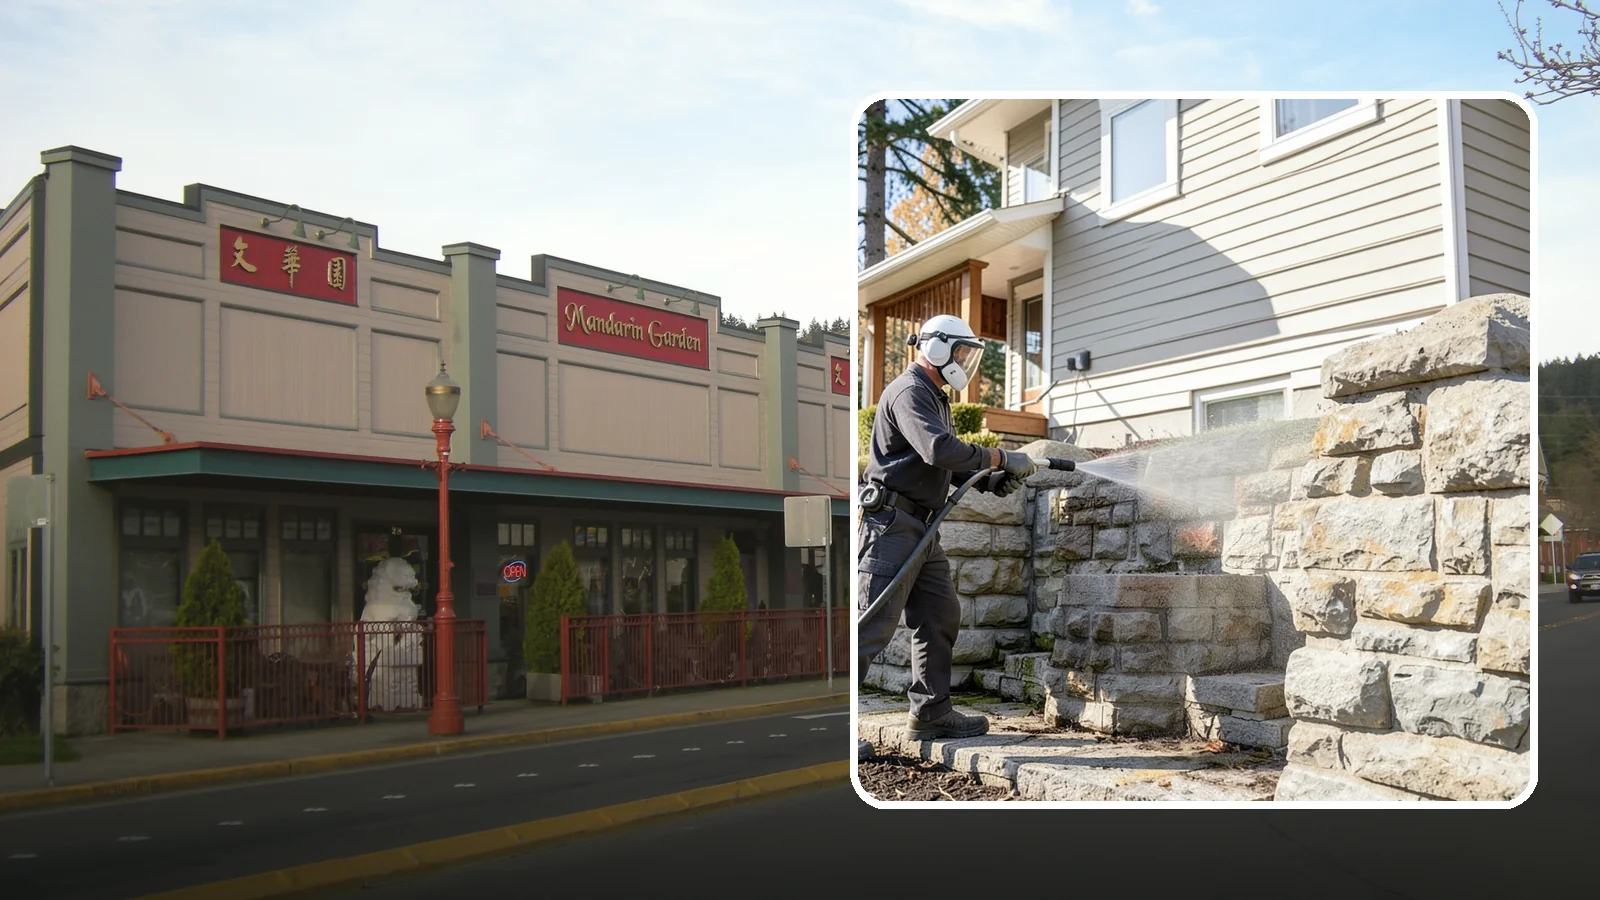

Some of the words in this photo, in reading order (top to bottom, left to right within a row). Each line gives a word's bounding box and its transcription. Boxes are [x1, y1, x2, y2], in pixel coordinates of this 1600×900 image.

[231, 236, 346, 290] 文華園
[564, 302, 644, 341] Mandarin
[647, 320, 701, 352] Garden
[503, 565, 527, 578] OPEN
